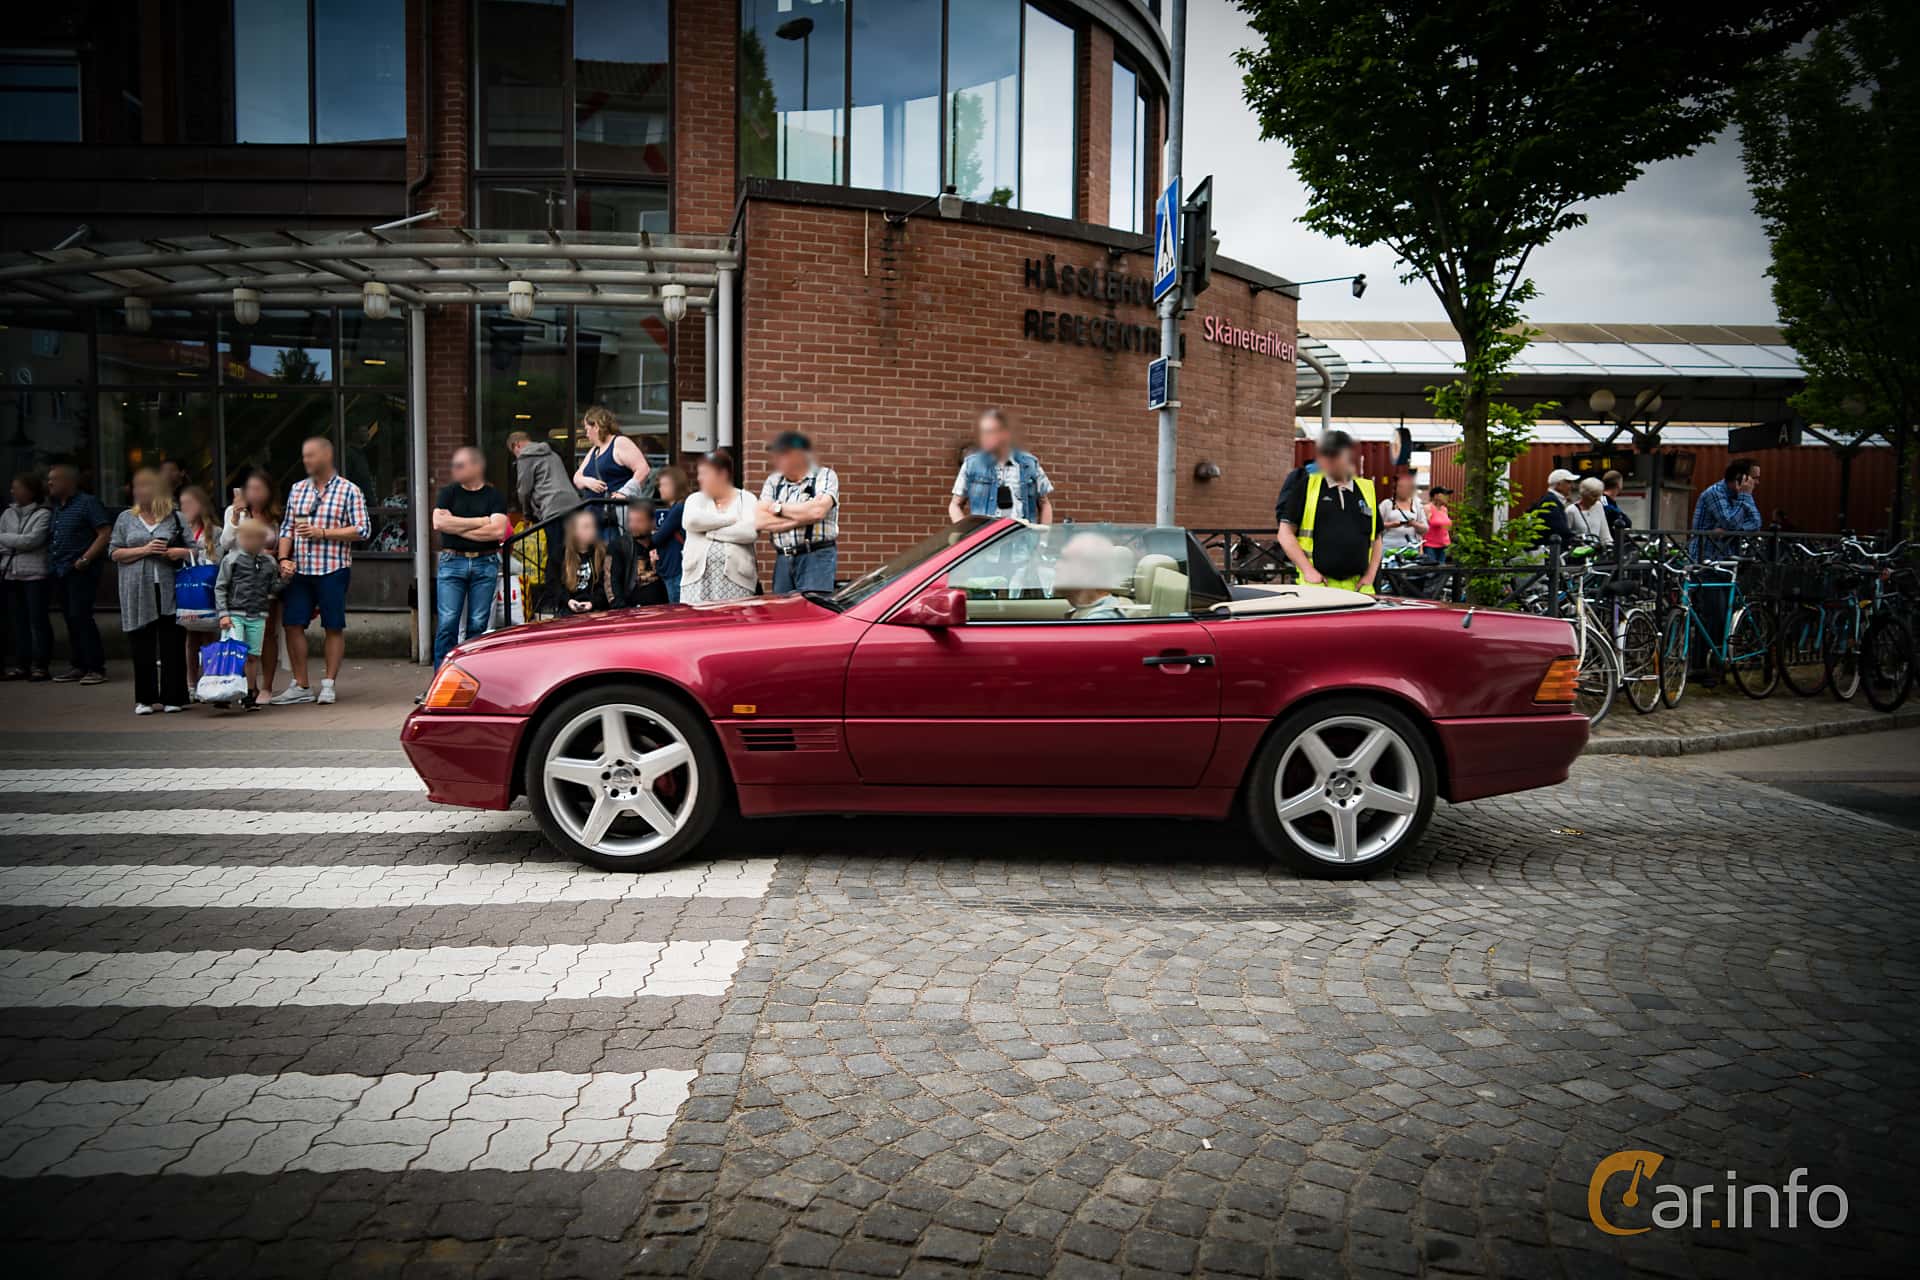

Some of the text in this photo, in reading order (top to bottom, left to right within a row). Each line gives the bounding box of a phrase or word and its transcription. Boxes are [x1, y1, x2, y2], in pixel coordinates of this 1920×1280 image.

[1024, 253, 1157, 307] HÄSSLEHO
[1024, 309, 1187, 359] RESECENTR
[1203, 315, 1296, 363] Skånetrafiken
[1777, 423, 1790, 444] A
